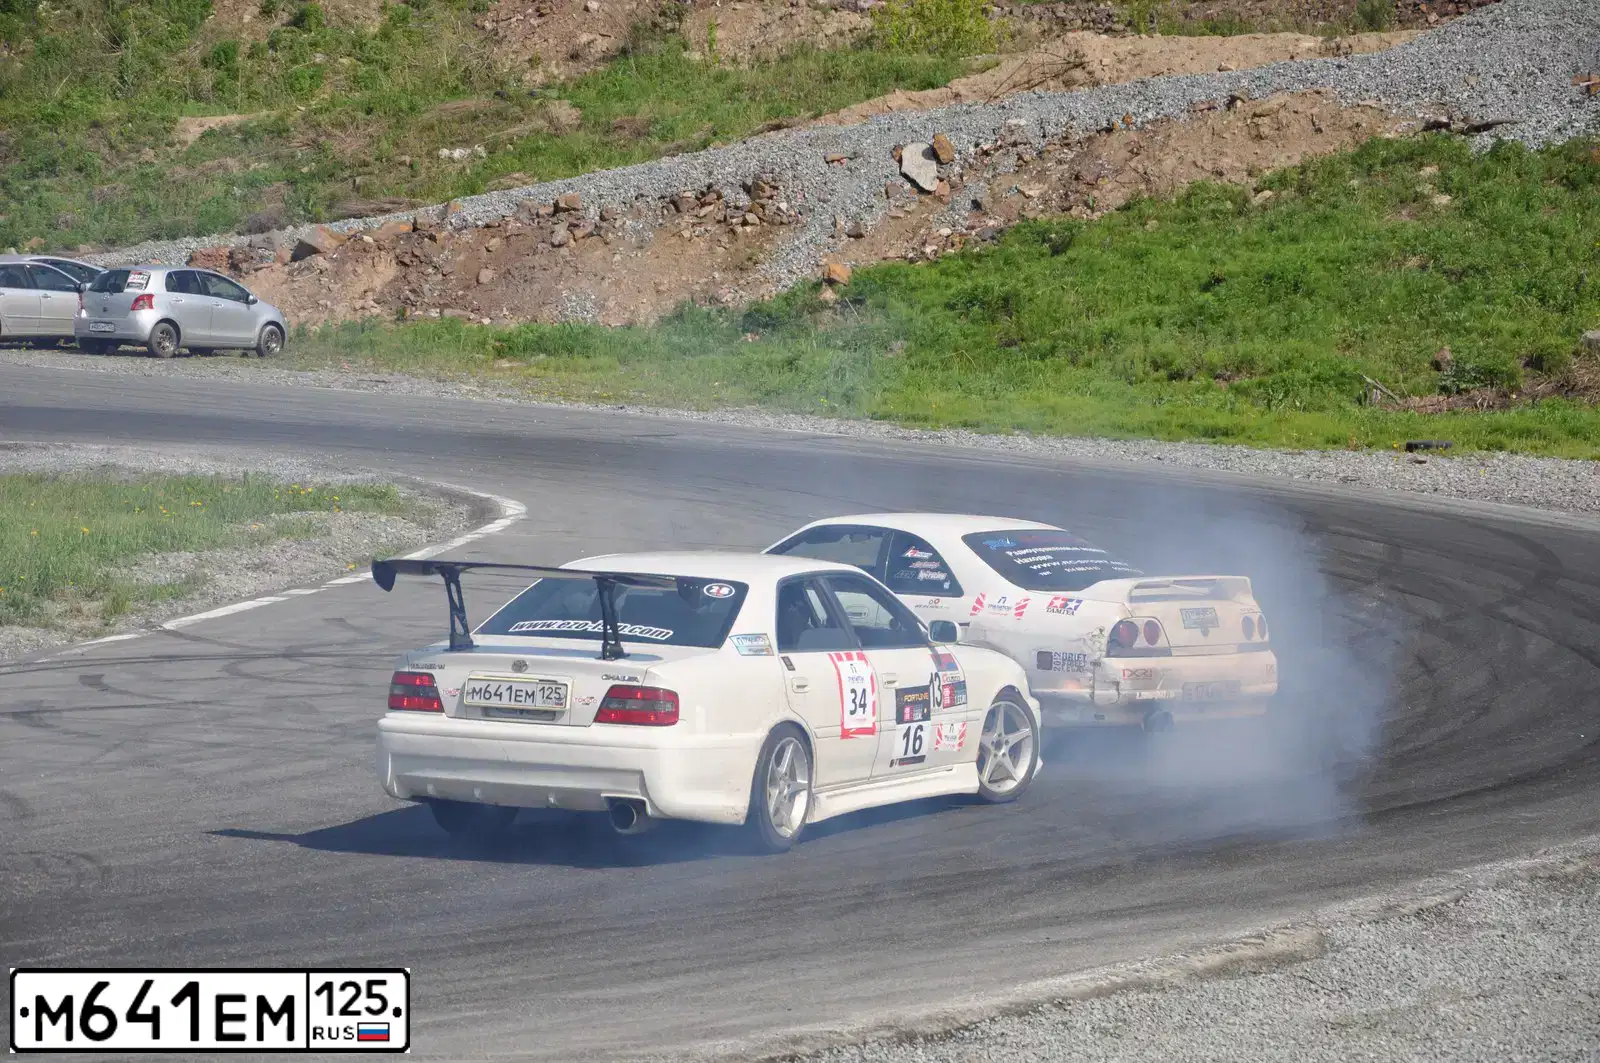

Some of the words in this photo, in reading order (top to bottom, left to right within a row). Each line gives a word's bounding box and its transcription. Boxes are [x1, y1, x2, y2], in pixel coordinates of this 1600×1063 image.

[1046, 607, 1075, 616] TAMIYA
[471, 684, 535, 703] М641ЕМ
[539, 687, 562, 700] 125
[849, 688, 867, 715] 34
[903, 692, 929, 702] FORTUNE
[902, 724, 924, 756] 16
